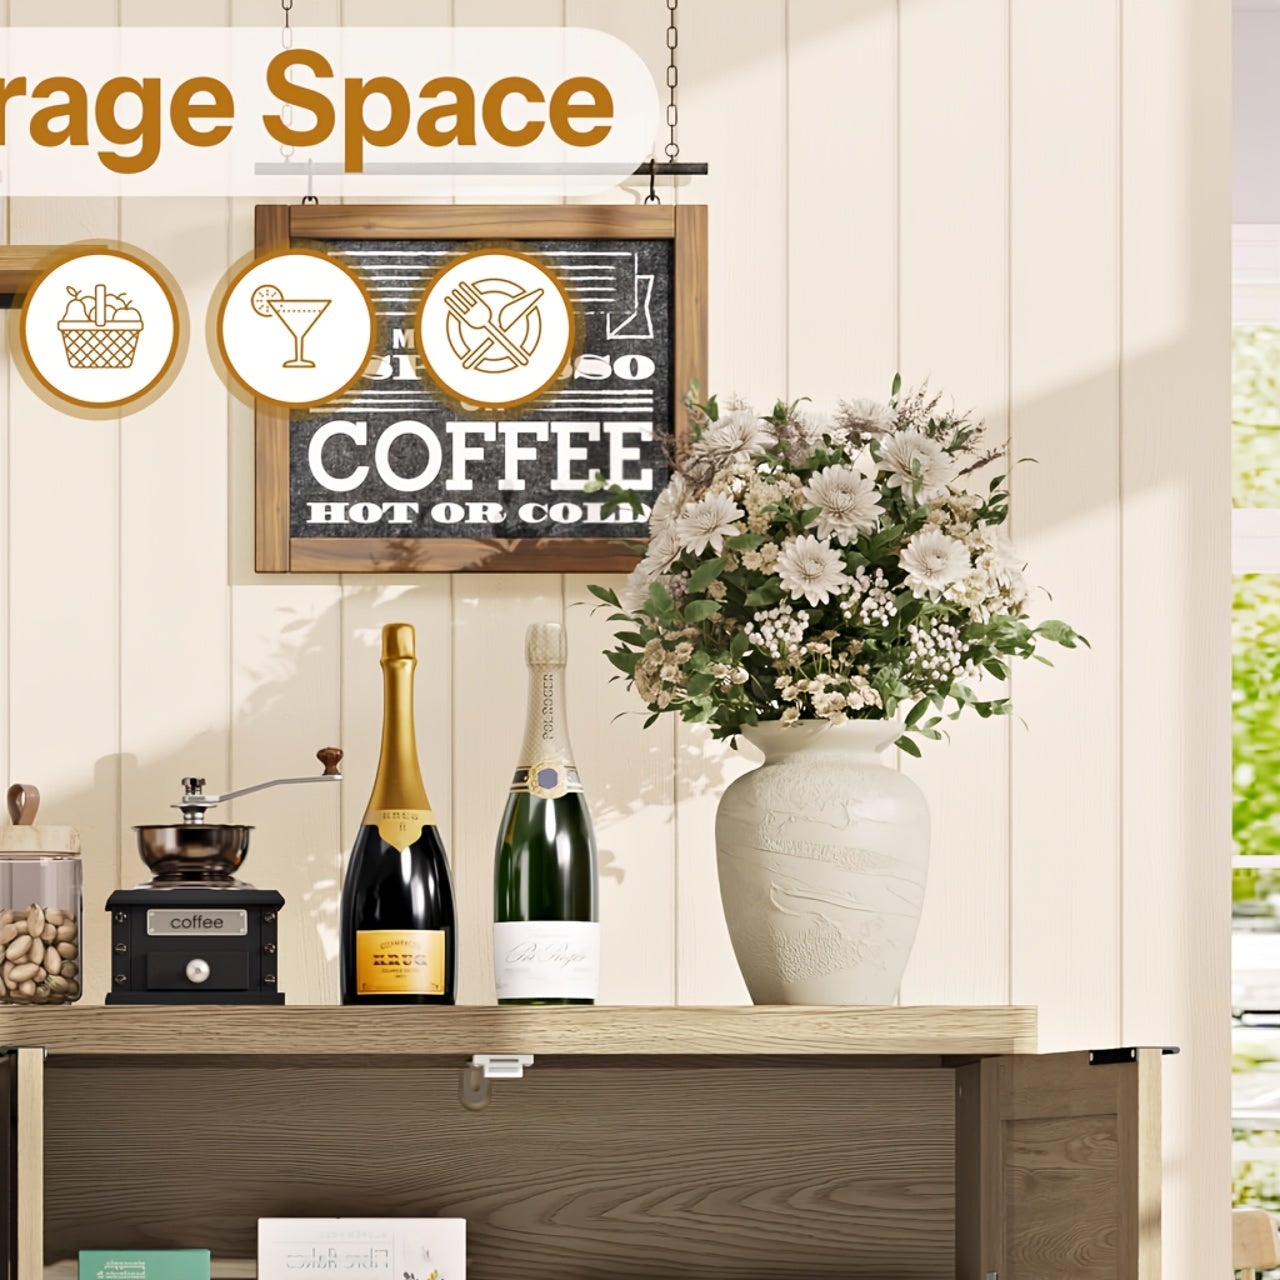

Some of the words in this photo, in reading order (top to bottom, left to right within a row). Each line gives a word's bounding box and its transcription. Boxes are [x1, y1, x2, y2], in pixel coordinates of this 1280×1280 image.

[308, 419, 654, 493] COFFEE
[306, 501, 419, 524] HOT
[431, 501, 507, 524] OR
[519, 501, 652, 524] COLD
[170, 914, 224, 929] coffee
